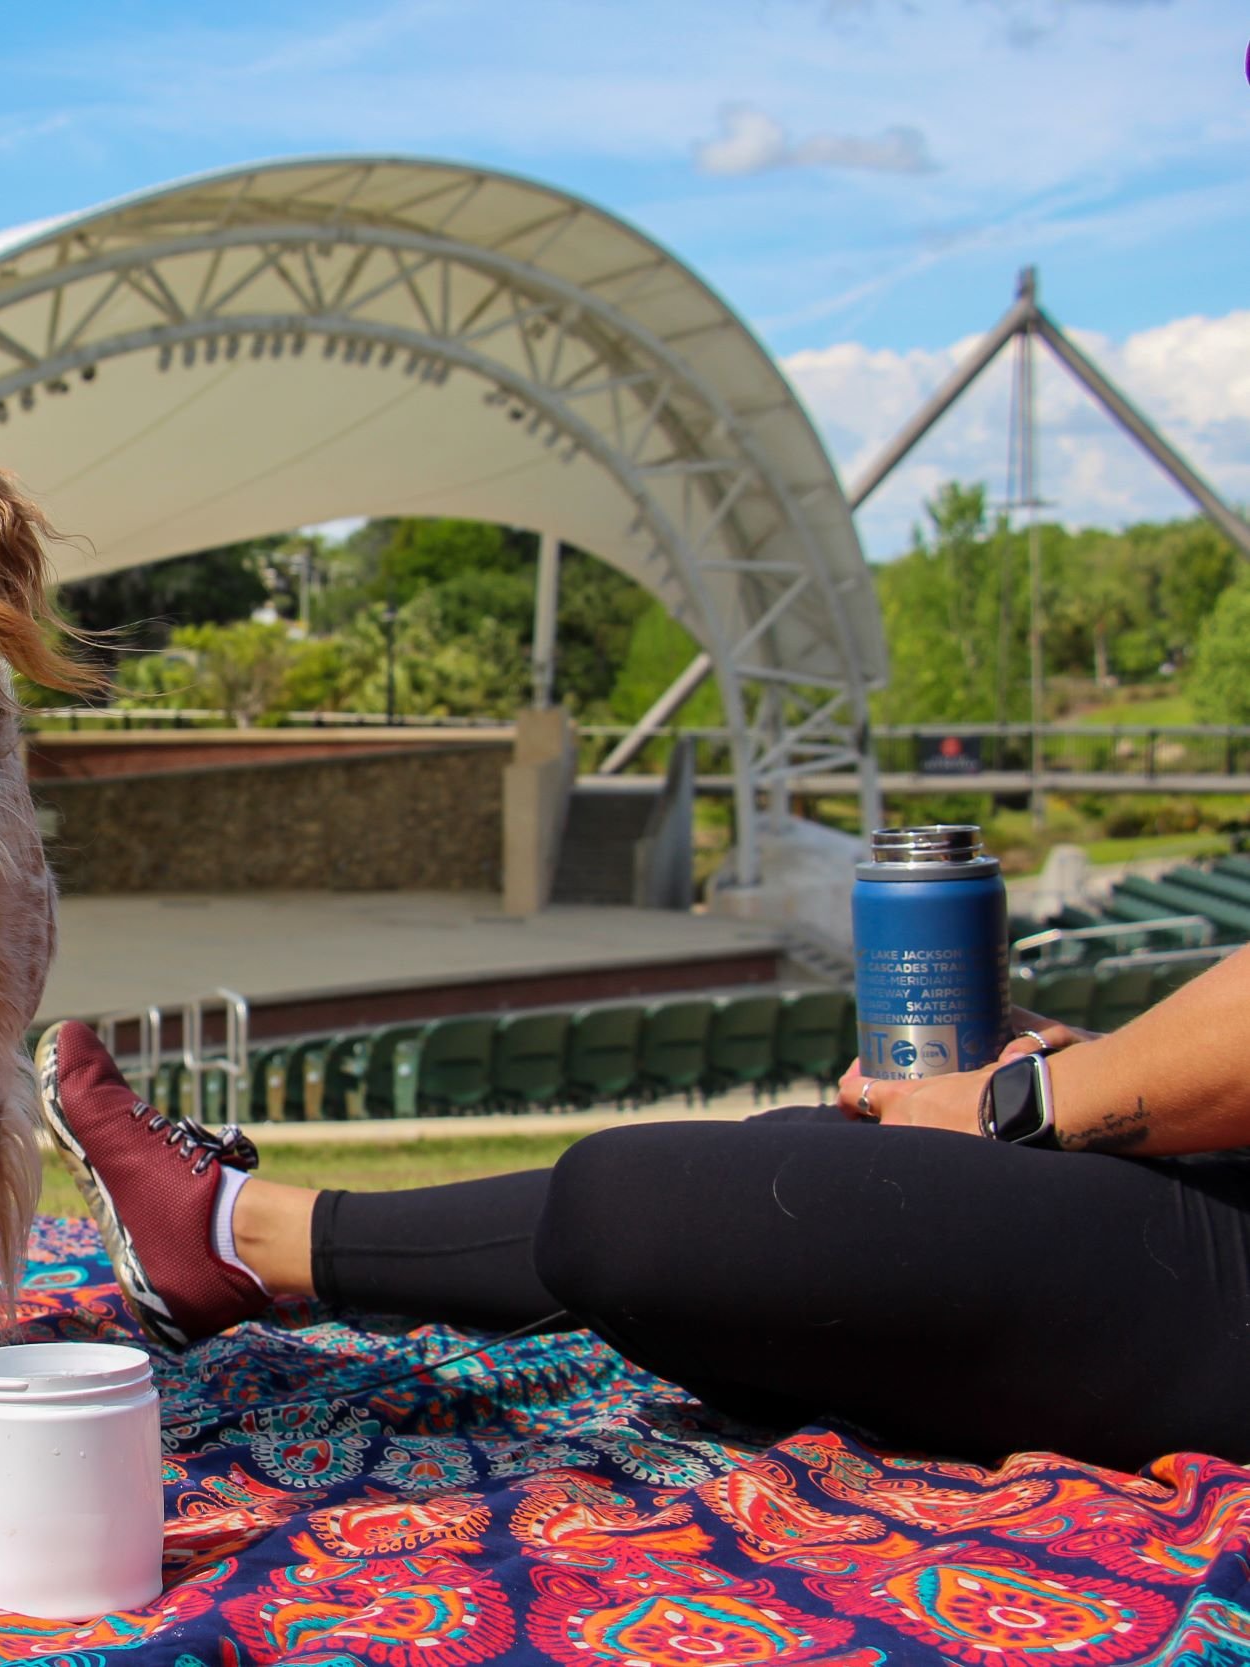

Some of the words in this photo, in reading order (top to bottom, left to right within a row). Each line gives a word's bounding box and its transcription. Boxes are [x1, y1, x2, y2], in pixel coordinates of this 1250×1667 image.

[871, 951, 898, 960] LAKE
[901, 950, 962, 961] JACKSON
[868, 963, 928, 973] CASCADES
